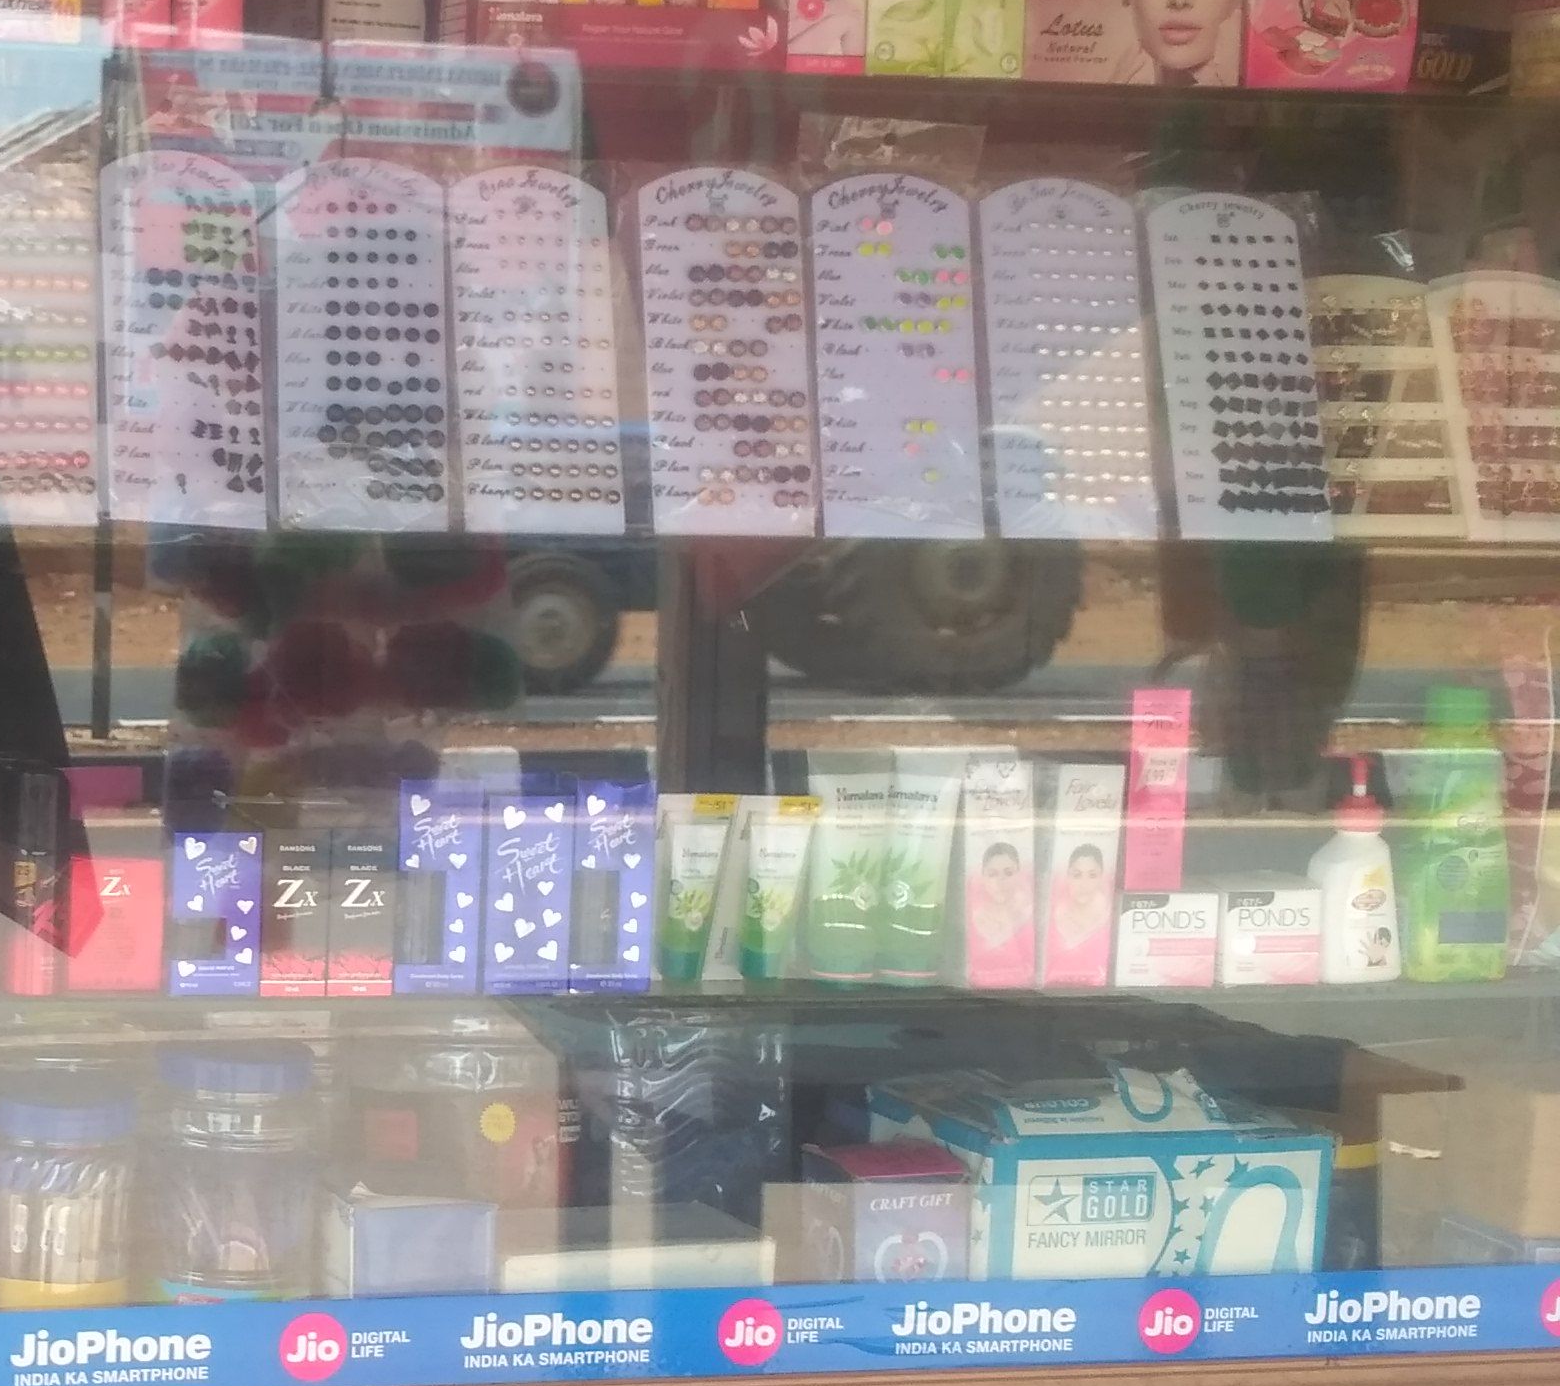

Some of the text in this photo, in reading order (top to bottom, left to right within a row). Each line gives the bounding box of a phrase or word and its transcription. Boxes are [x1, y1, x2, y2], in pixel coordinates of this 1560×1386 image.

[1040, 14, 1105, 37] Lotus
[1131, 909, 1207, 931] POND'S
[1238, 907, 1311, 928] POND'S
[1089, 1179, 1148, 1195] STAR
[869, 1192, 953, 1212] CRAFT GIFT
[1086, 1193, 1149, 1219] GOLD
[1027, 1229, 1147, 1249] FANCY MIRROR
[1203, 1306, 1259, 1321] DIGITAL
[1304, 1288, 1481, 1325] JioPhone
[787, 1316, 844, 1331] DIGITAL
[891, 1300, 1077, 1337] JioPhone
[1144, 1306, 1194, 1337] Jio
[1203, 1319, 1234, 1334] LIFE
[351, 1330, 411, 1345] DIGITAL
[459, 1312, 653, 1350] JioPhone
[724, 1316, 777, 1349] Jio
[787, 1329, 819, 1344] LIFE
[1307, 1324, 1477, 1343] INDIA KA SMARTPHONE
[10, 1328, 213, 1368] JioPhone
[286, 1331, 340, 1364] Jio
[351, 1344, 384, 1359] LIFE
[895, 1337, 1074, 1356] INDIA KA SMARTPHONE
[463, 1348, 650, 1369] INDIA KA SMARTPHONE
[65, 1370, 89, 1385] KA
[91, 1365, 209, 1384] SMARTPHONE
